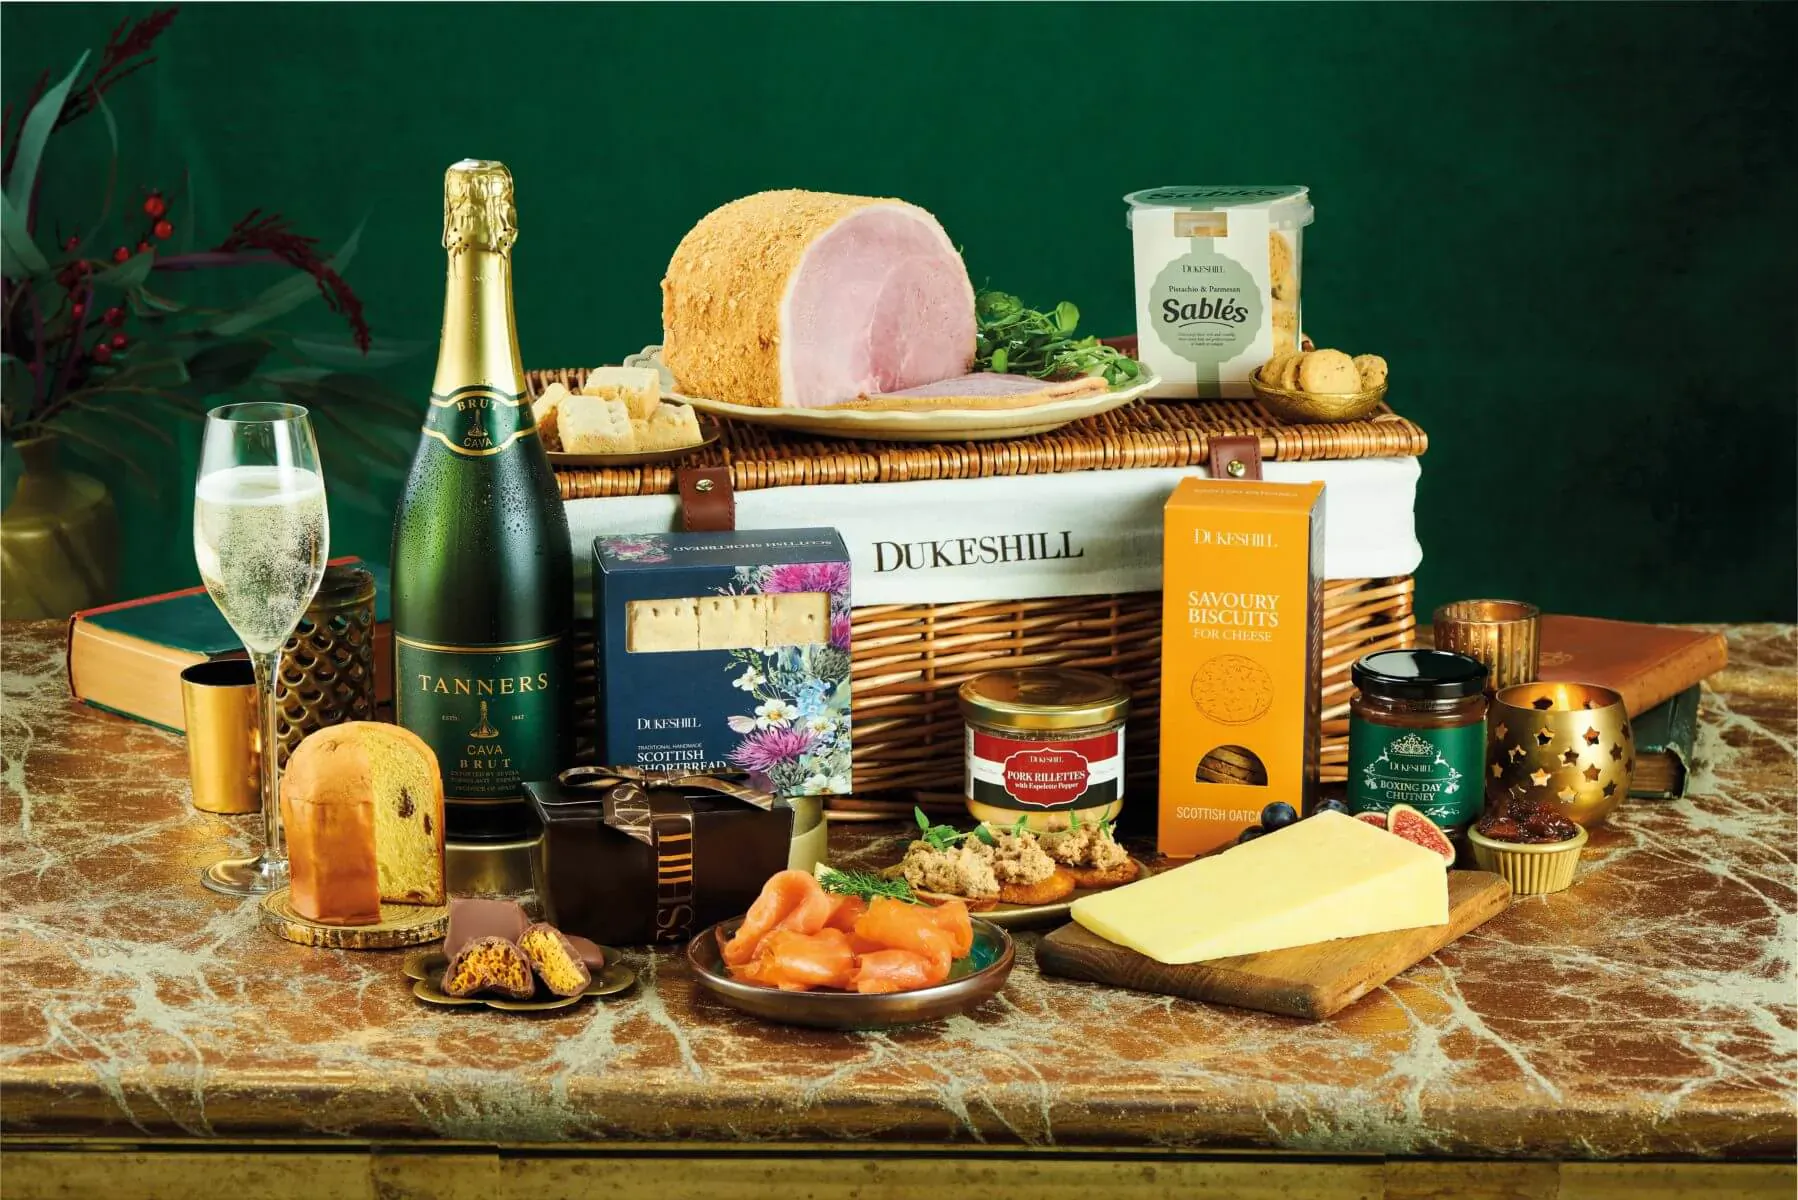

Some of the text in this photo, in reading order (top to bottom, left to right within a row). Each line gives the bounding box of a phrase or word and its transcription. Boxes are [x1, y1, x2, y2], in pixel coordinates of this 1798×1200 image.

[1168, 285, 1199, 293] Pistachio
[1209, 285, 1241, 293] Parmesan
[1162, 297, 1249, 323] Sablés
[456, 398, 499, 412] BRUT
[463, 437, 493, 449] CAVA
[1193, 528, 1278, 548] DUKESHILL
[872, 531, 1084, 573] DUKESHILL
[1188, 591, 1281, 609] SAVOURY
[1188, 608, 1279, 628] BISCUITS
[1193, 628, 1273, 643] FOR CHEESE
[418, 673, 548, 695] TANNERS
[637, 717, 702, 730] DUKESHILL
[467, 745, 503, 756] CAVA
[637, 750, 704, 762] SCOTTISH
[460, 758, 511, 769] BRUT
[1007, 770, 1032, 782] PORK
[1035, 770, 1086, 782] RILLETTES
[1058, 782, 1079, 790] Pepper
[1380, 780, 1442, 792] BOXING DAY
[1386, 791, 1436, 801] CHUTNEY
[1176, 806, 1262, 823] SCOTTISH OATCA
